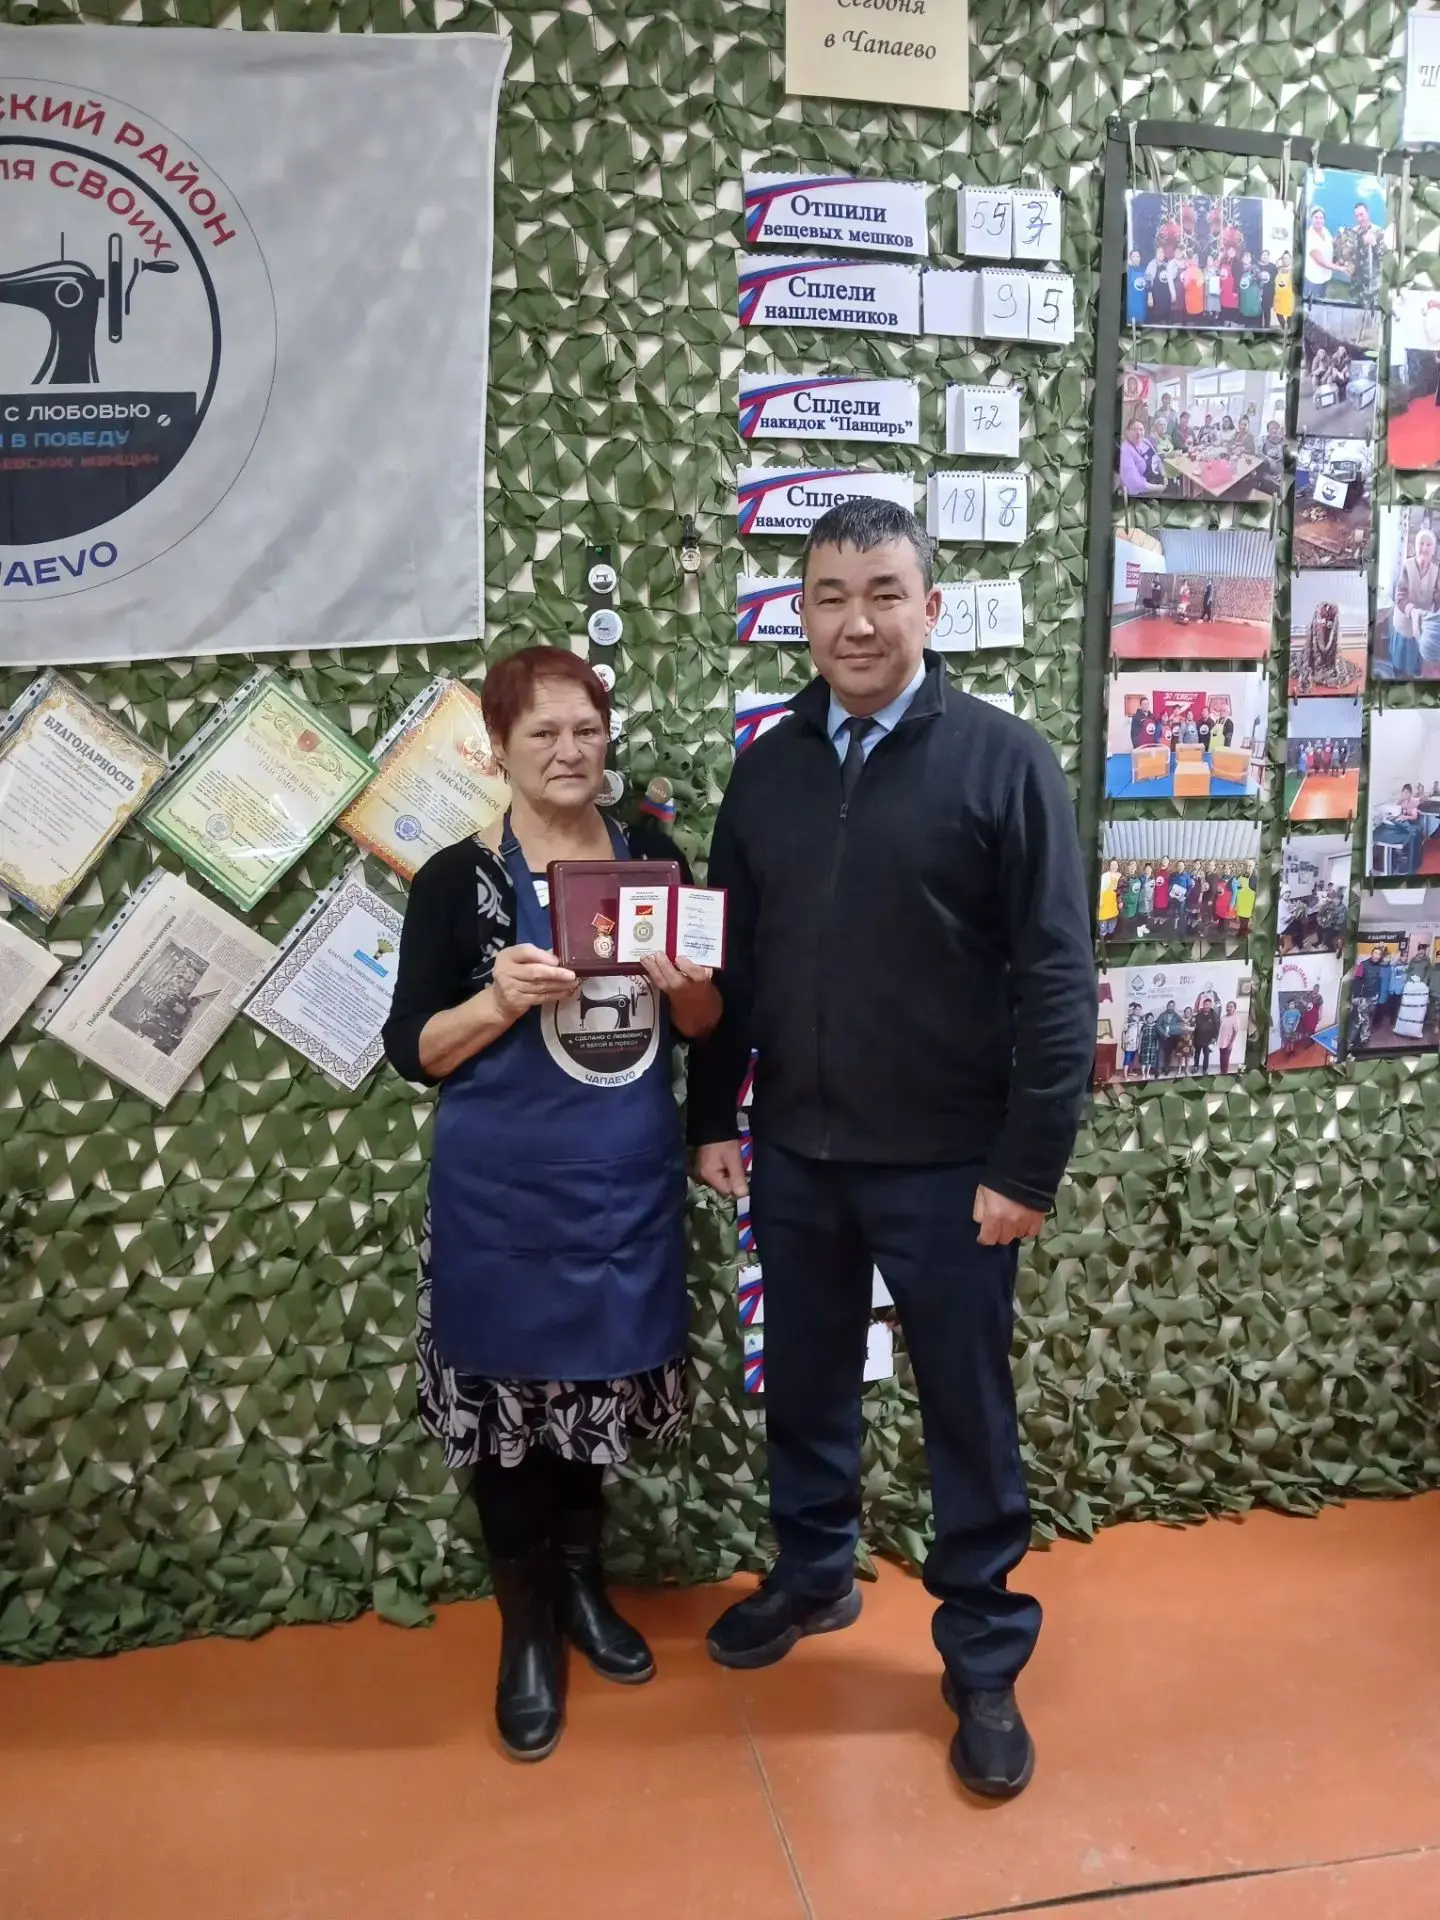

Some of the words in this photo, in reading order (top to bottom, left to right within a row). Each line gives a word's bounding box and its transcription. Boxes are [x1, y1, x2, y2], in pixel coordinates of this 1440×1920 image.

[824, 33, 836, 48] в
[842, 29, 937, 60] Чапаево
[113, 121, 236, 247] РАЙОН
[49, 160, 172, 258] СВОИХ
[790, 194, 888, 223] Отшили
[763, 223, 844, 241] вещевых
[848, 229, 914, 248] мешков
[788, 275, 876, 302] Сплели
[993, 283, 1018, 319] 9
[764, 304, 899, 326] нашлемников
[4, 406, 20, 422] С
[26, 403, 151, 422] ЛЮБОВЬЮ
[793, 391, 881, 416] Сплели
[760, 416, 826, 432] накидок
[829, 416, 913, 437] “Панцирь”
[972, 405, 1003, 431] 72
[11, 433, 27, 448] В
[34, 429, 130, 448] ПОБЕДУ
[942, 487, 977, 524] 18
[987, 598, 999, 630] 8
[43, 715, 135, 792] БЛАГОДАРНОСТЬ
[435, 769, 474, 802] ПИСЬМО
[574, 1034, 605, 1042] СДЕЛАНО
